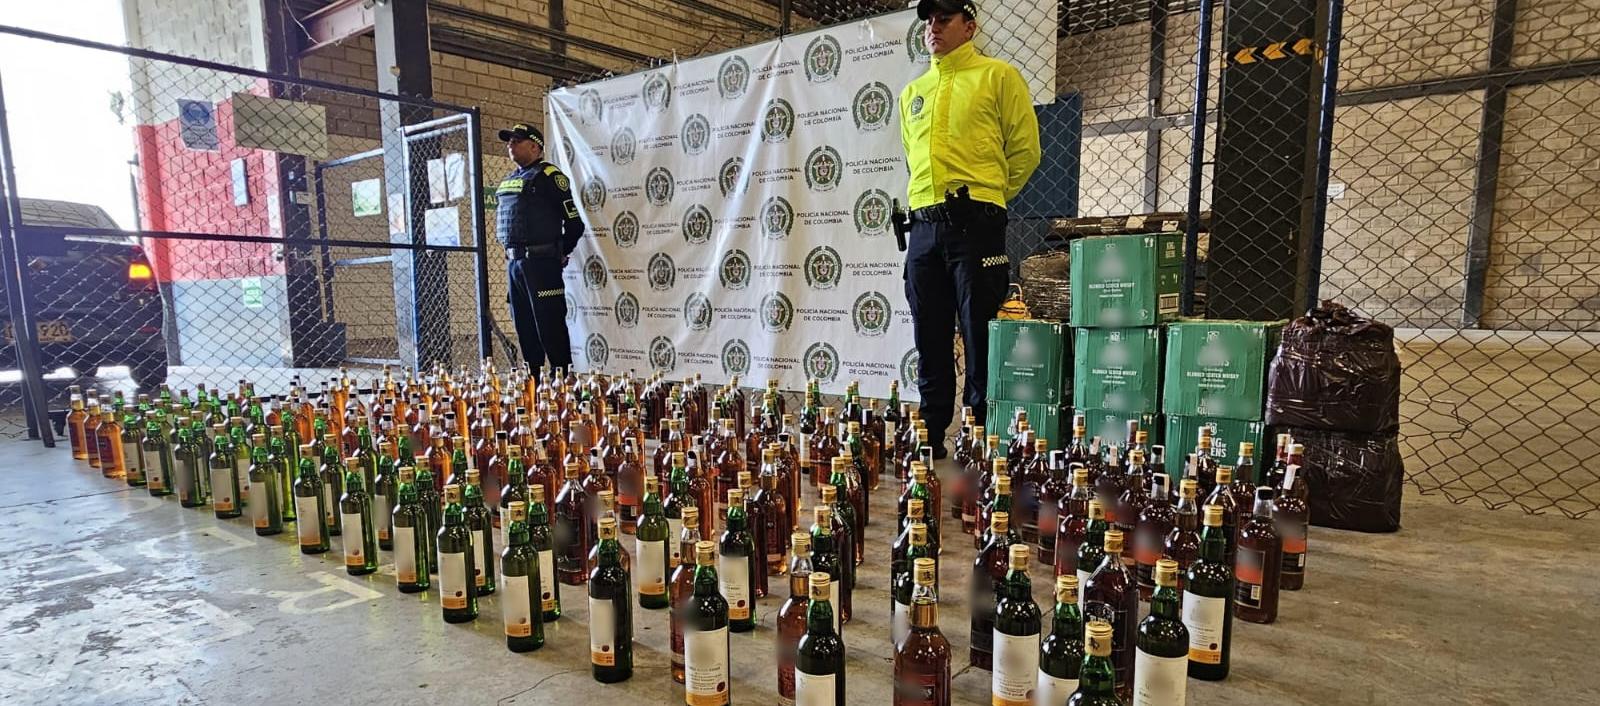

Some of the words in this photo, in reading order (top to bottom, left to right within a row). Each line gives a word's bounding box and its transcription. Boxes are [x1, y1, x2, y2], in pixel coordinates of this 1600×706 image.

[869, 39, 902, 50] NACIONAL
[862, 50, 894, 60] COLOMBIA
[766, 69, 794, 79] COMBIA
[820, 106, 848, 116] NACIONAL
[813, 116, 842, 125] COLOMBIA
[870, 156, 901, 165] NACIONAL
[861, 165, 894, 174] COLOMBIA
